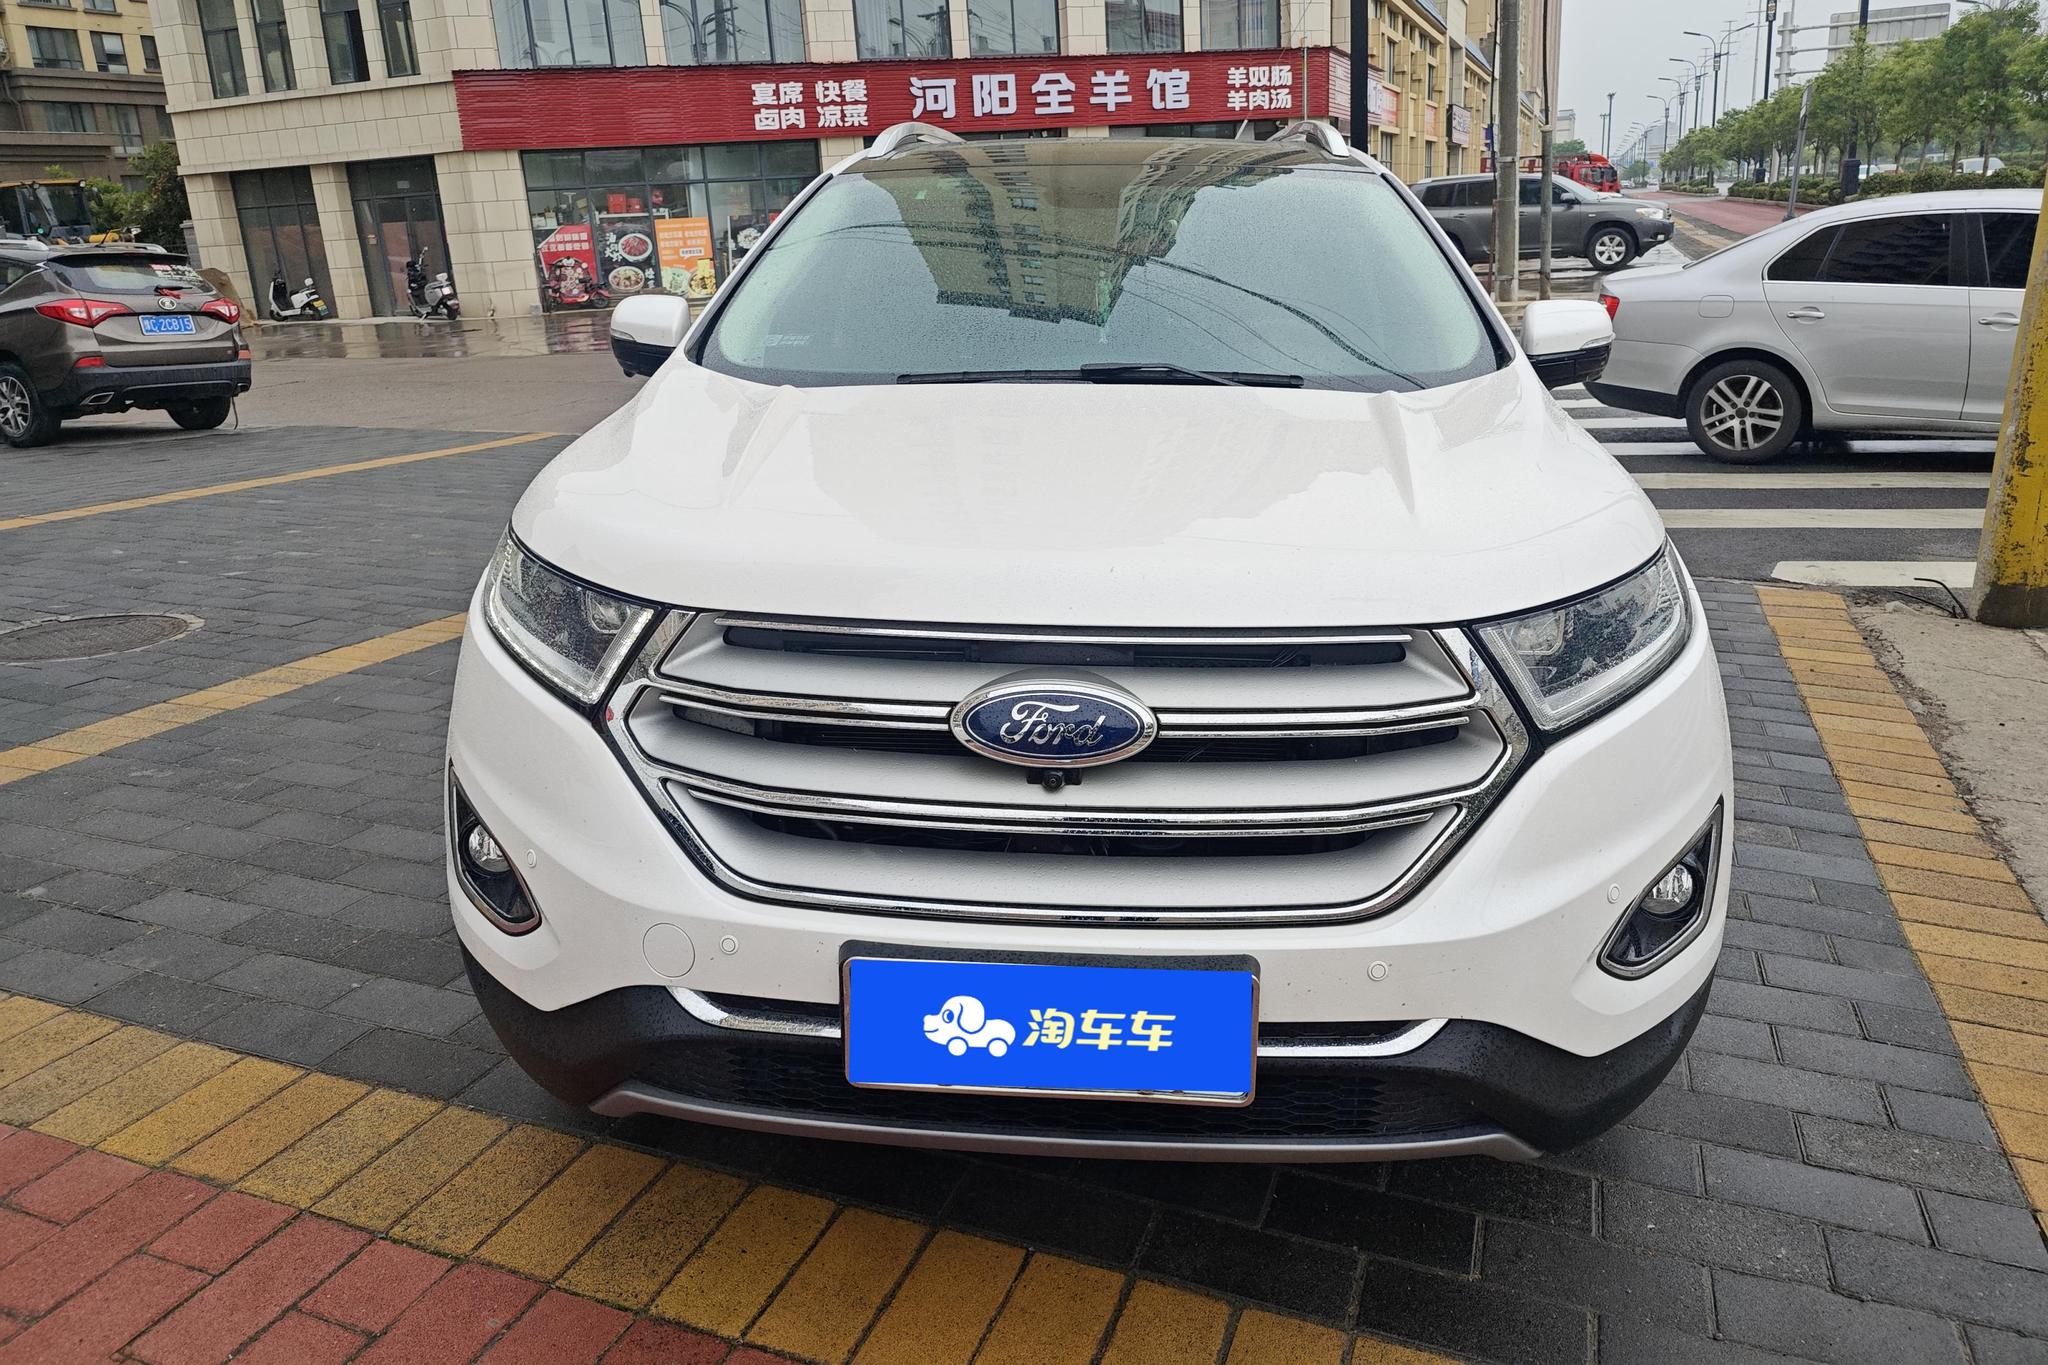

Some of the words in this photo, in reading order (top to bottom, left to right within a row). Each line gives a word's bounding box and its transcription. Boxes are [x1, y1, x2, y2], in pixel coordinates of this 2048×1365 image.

[1227, 65, 1293, 88] 羊双肠
[751, 81, 804, 105] 宴席
[815, 79, 868, 103] 快餐
[909, 68, 1190, 119] 河阳全羊馆
[1227, 88, 1293, 111] 羊肉汤
[754, 107, 806, 130] 卤肉
[816, 104, 869, 128] 凉菜
[1000, 700, 1106, 747] Ford
